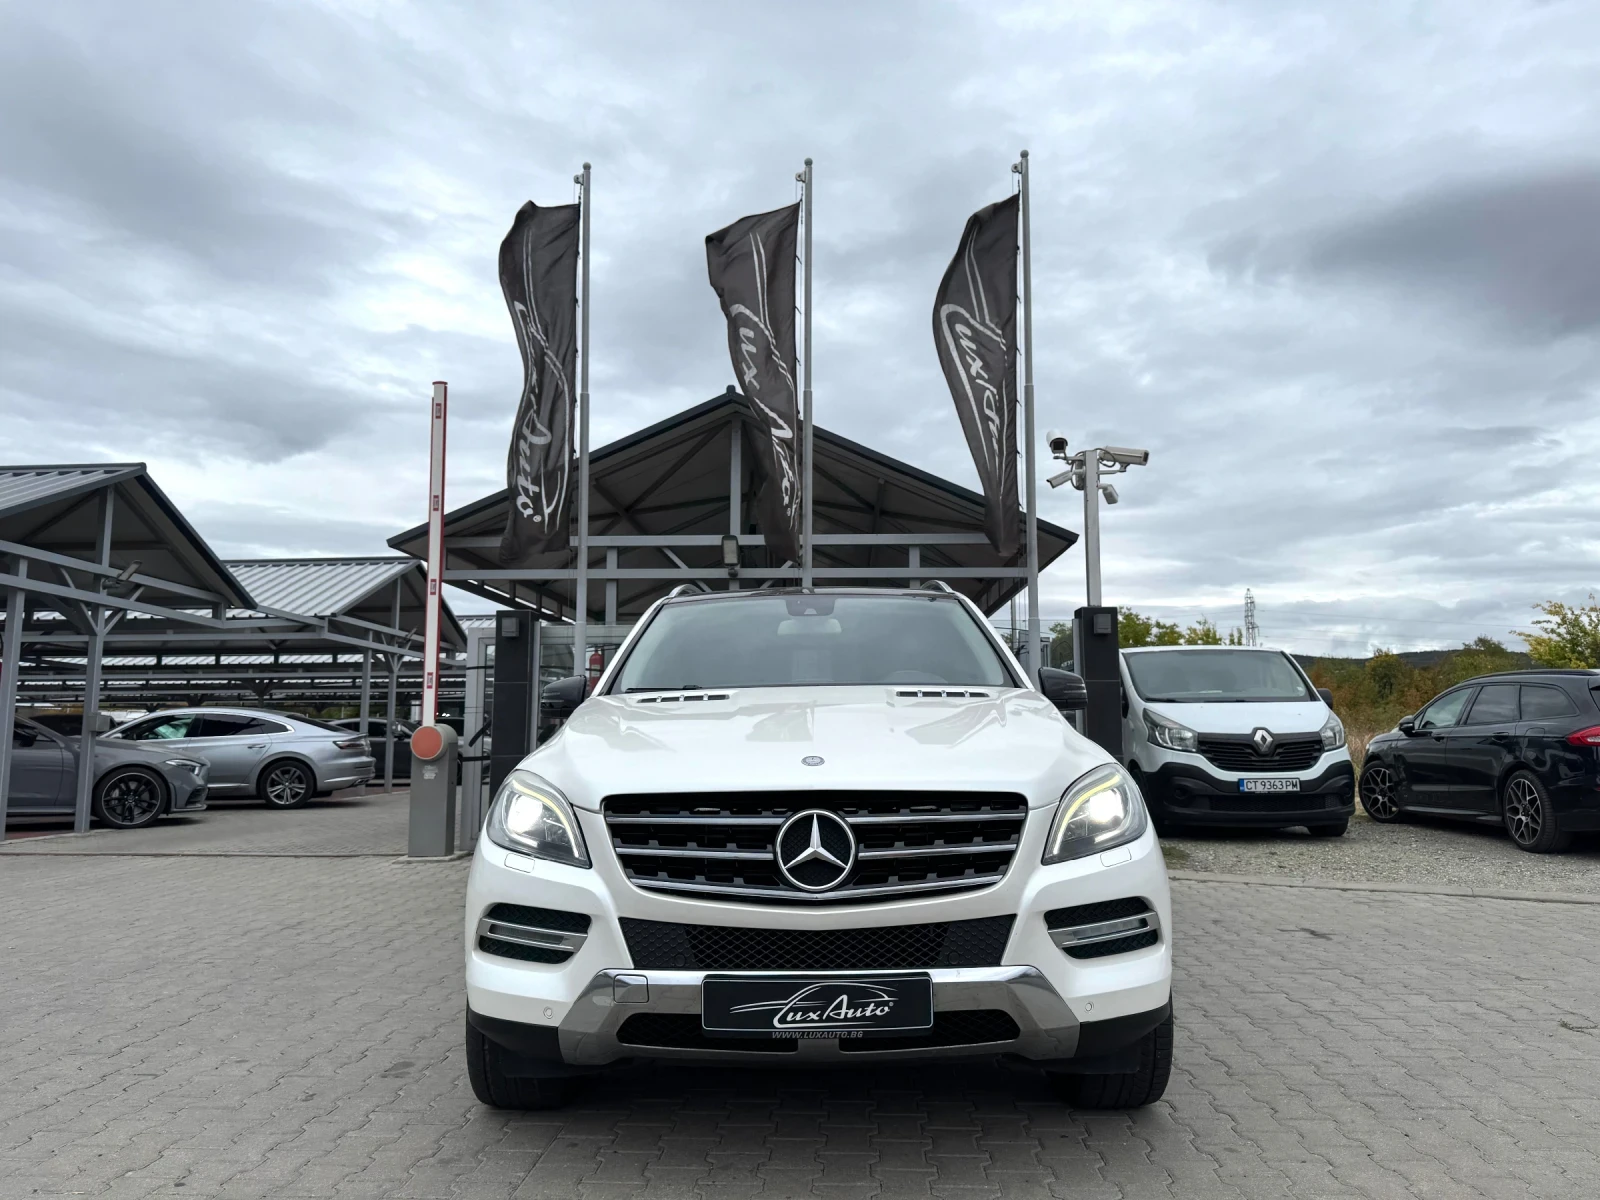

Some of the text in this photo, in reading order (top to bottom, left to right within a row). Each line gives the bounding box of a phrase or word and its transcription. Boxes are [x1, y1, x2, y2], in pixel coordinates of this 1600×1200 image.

[1246, 780, 1299, 790] CT 9363 PM
[772, 1031, 864, 1039] WWW.LUXAUTO.BG
